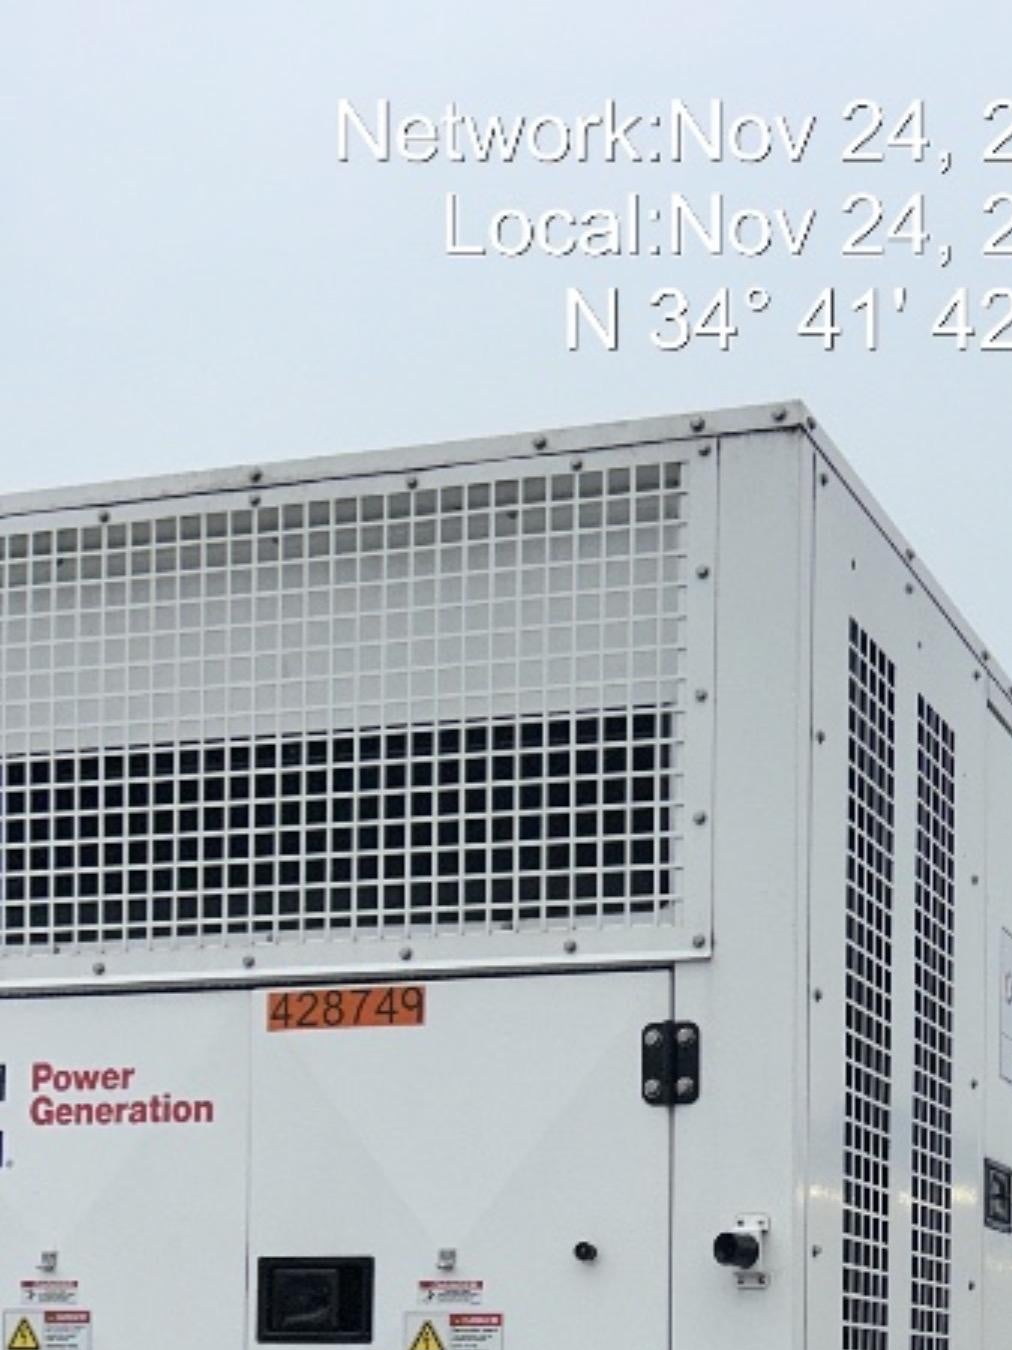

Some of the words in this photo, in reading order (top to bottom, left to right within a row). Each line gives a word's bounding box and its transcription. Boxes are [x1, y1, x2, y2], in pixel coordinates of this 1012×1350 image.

[269, 986, 425, 1028] 428749
[31, 1061, 136, 1093] Power
[29, 1093, 214, 1126] Generation
